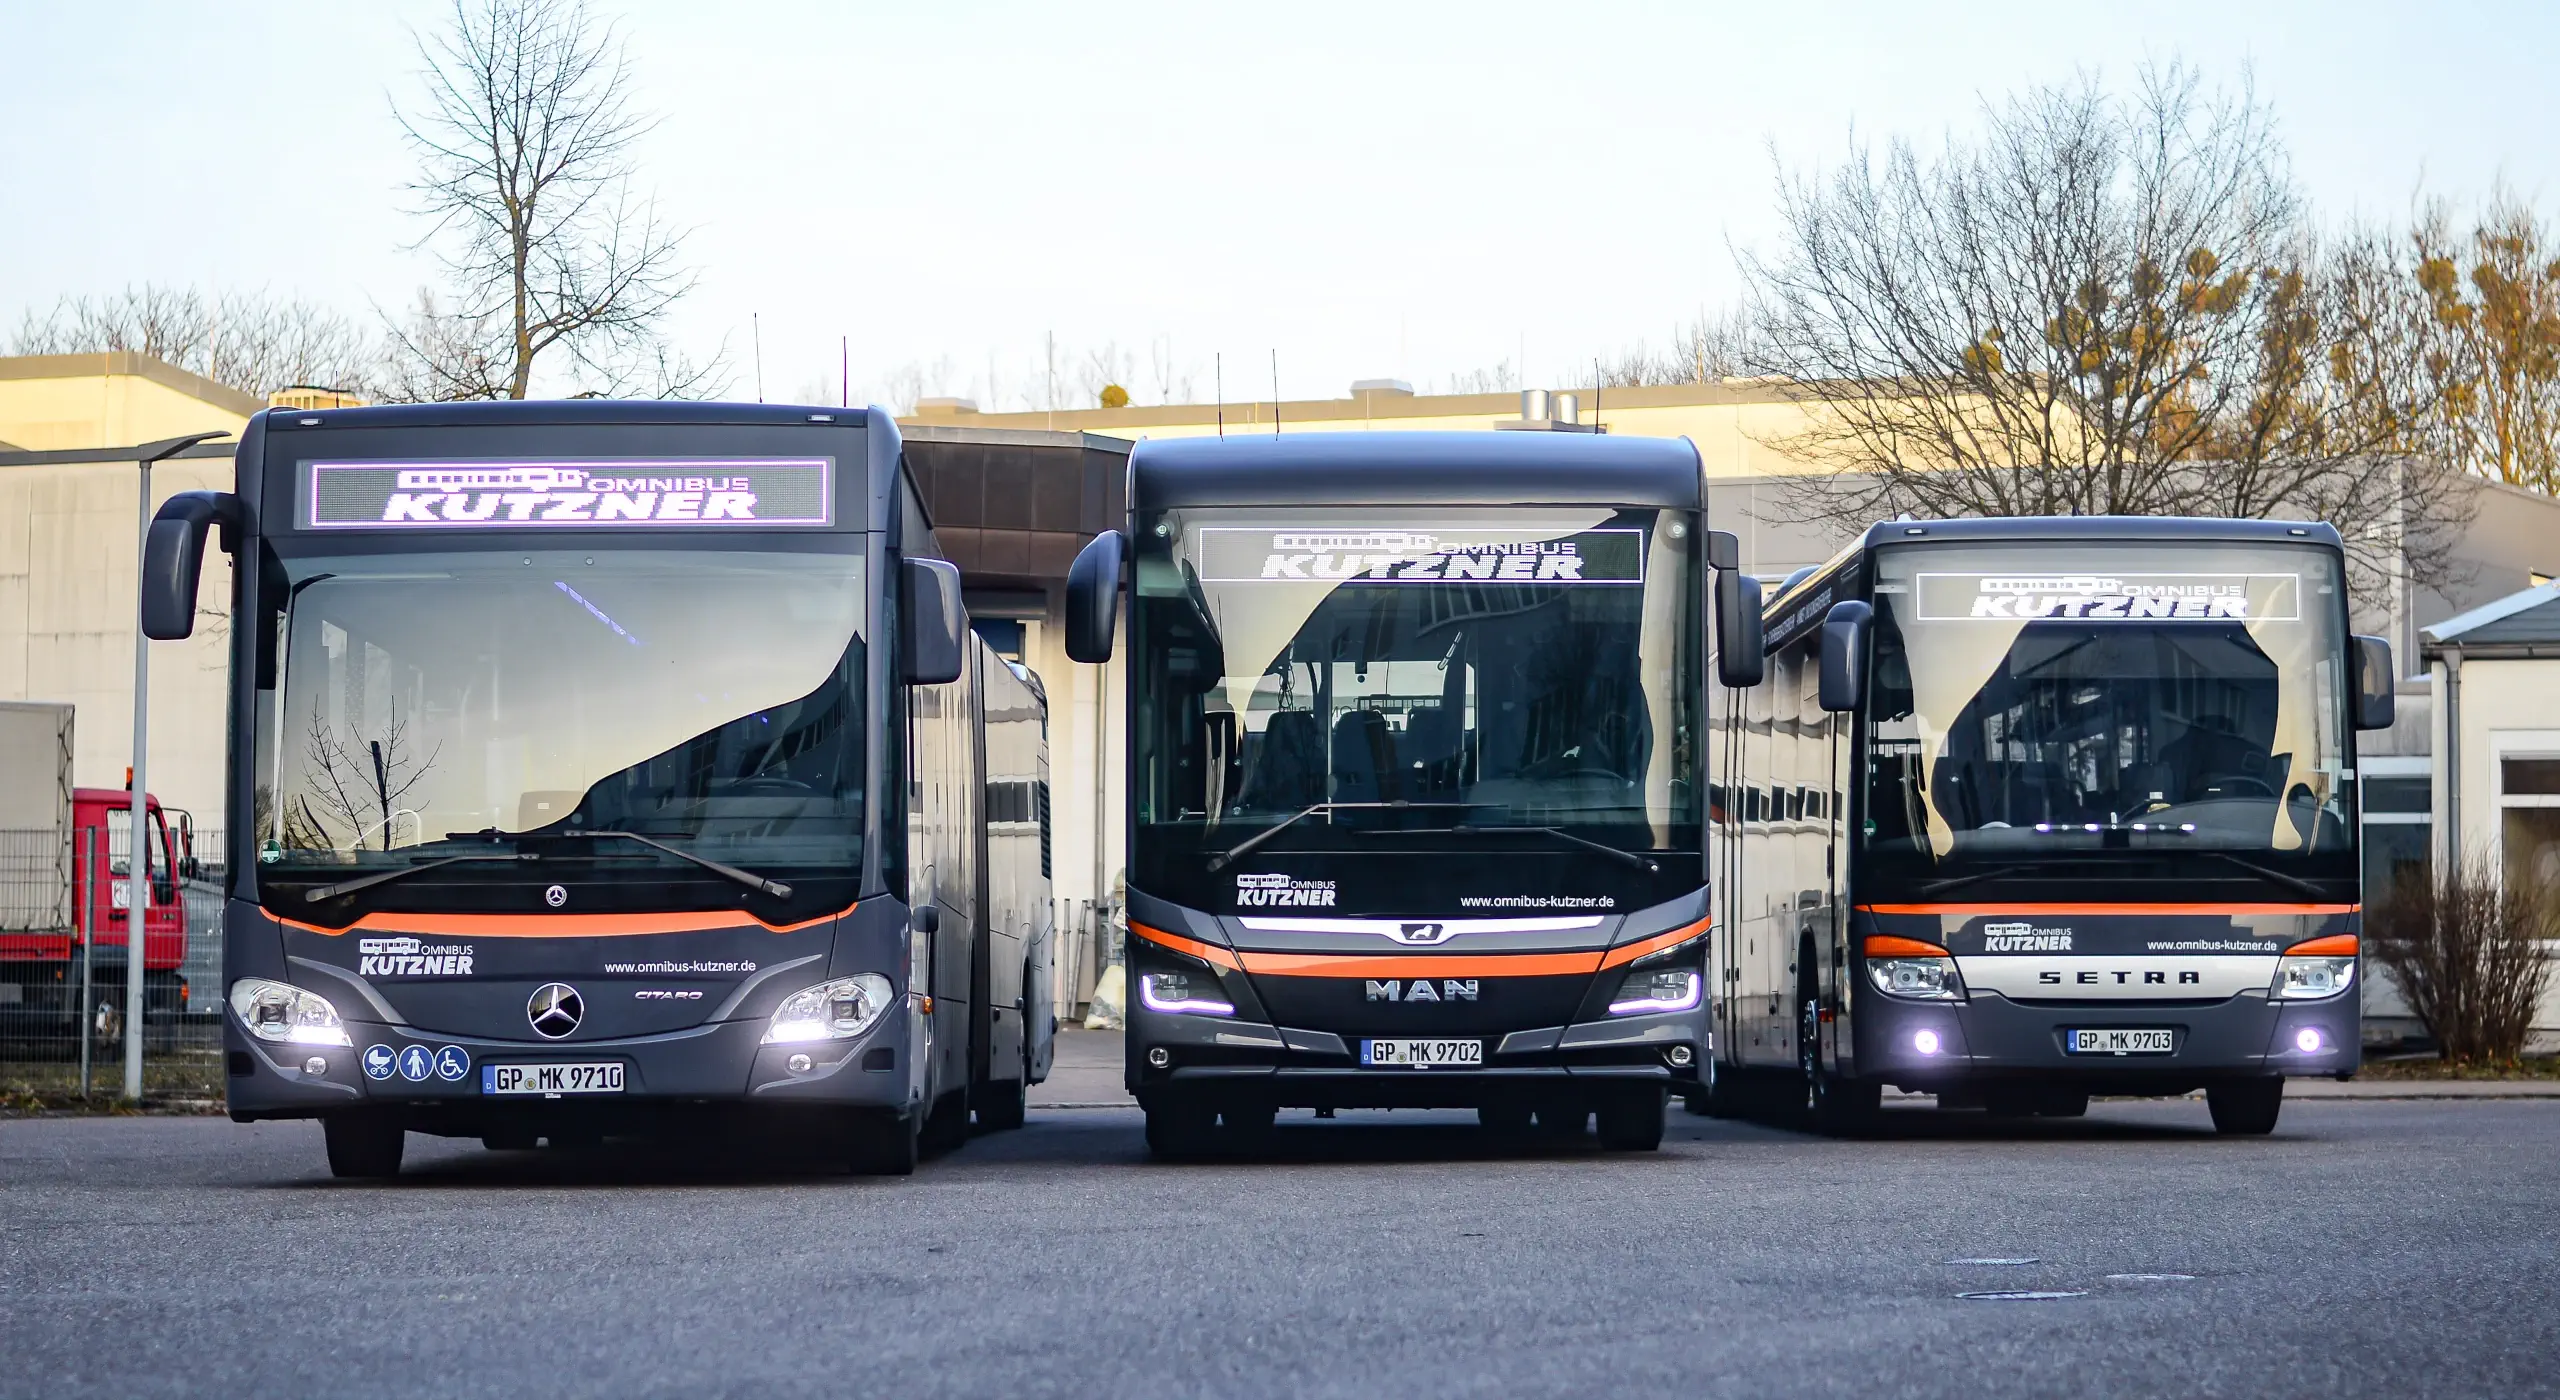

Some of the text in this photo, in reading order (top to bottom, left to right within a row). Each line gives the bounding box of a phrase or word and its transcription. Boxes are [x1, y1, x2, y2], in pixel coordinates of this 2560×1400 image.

[587, 477, 749, 492] OMNIBUS
[382, 493, 757, 520] KUTZNER
[1437, 542, 1576, 555] OMNIBUS
[1260, 554, 1584, 579] KUTZNER
[2121, 585, 2241, 597] OMNIBUS
[1969, 596, 2248, 617] KUTZNER
[1290, 880, 1336, 890] OMNIBUS
[1237, 889, 1336, 906] KUTZNER
[1460, 895, 1615, 908] www.omnibus-kutzner.de
[2031, 927, 2072, 936] OMNIBUS
[421, 945, 474, 955] OMNIBUS
[1985, 936, 2072, 951] KUTZNER
[2147, 938, 2278, 952] www.omnibus-kutzner.de
[360, 956, 474, 975] KUTZNER
[604, 960, 757, 973] www.omnibus-kutzner.de
[2039, 971, 2200, 985] SETRA
[634, 991, 704, 1000] CITARO
[1365, 980, 1478, 1001] MAN
[2079, 1033, 2171, 1049] GP MK 9703
[1373, 1042, 1480, 1062] GP MK 9702
[497, 1066, 621, 1090] GP MK 9710
[485, 1082, 492, 1090] D
